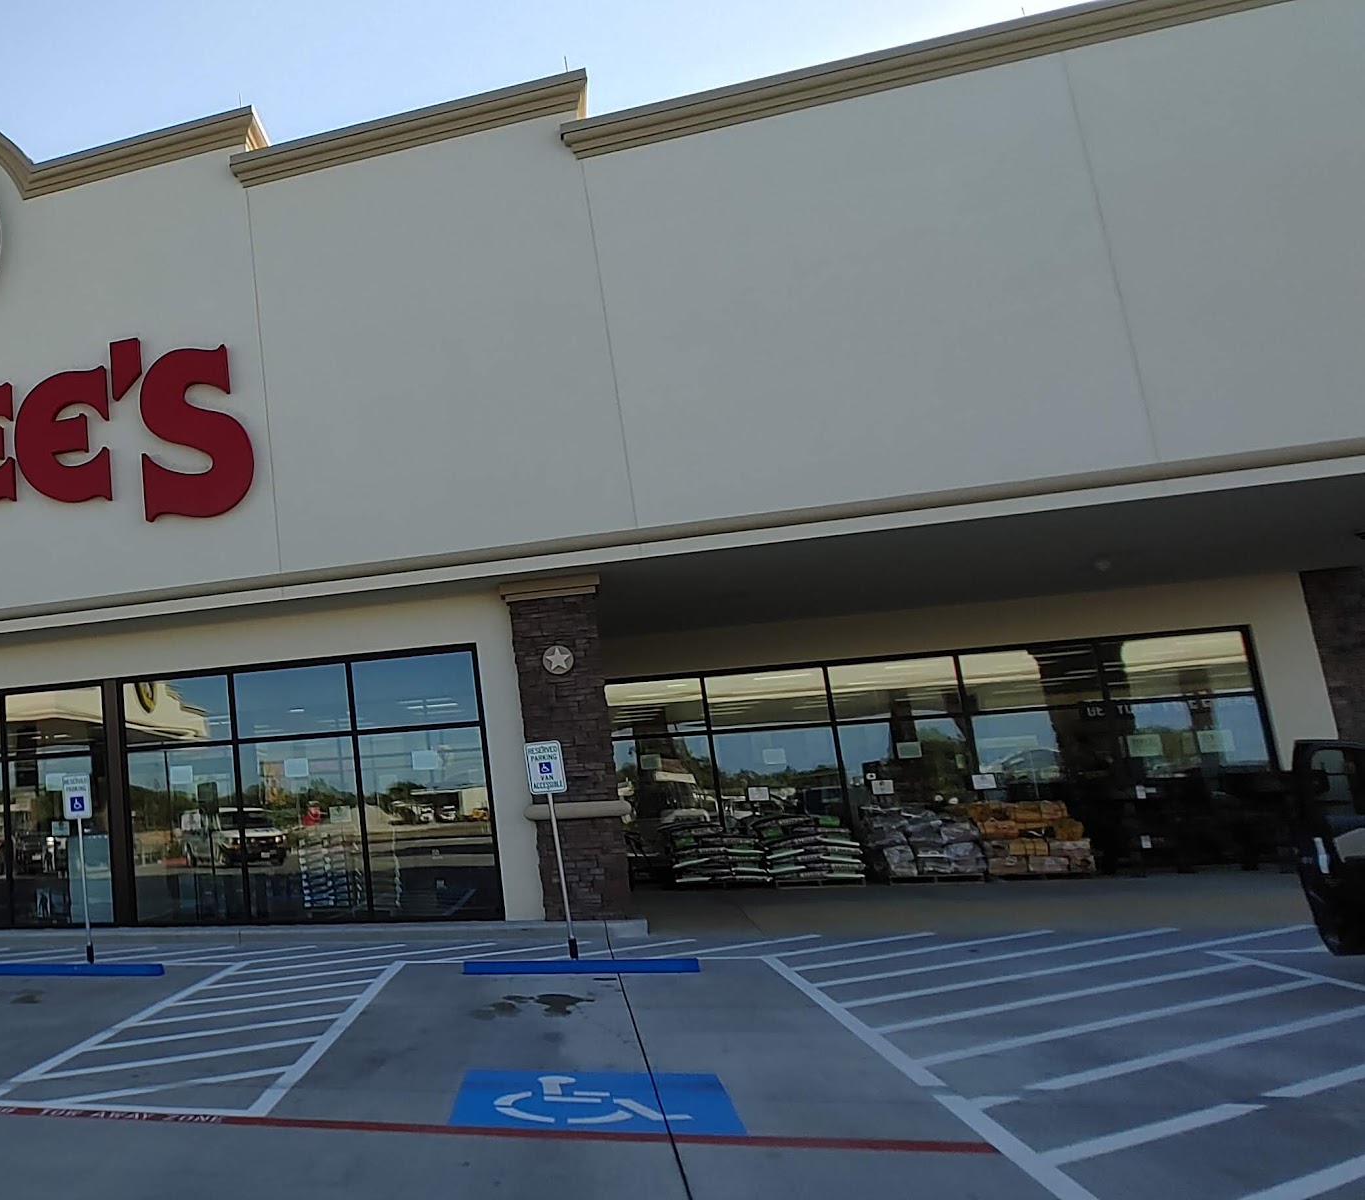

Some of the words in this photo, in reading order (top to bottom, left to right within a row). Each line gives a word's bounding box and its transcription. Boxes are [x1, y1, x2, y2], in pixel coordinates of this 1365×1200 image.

[527, 746, 558, 754] RESERVED
[534, 781, 563, 789] ACCESSIBLE
[162, 1114, 225, 1125] ZONE
